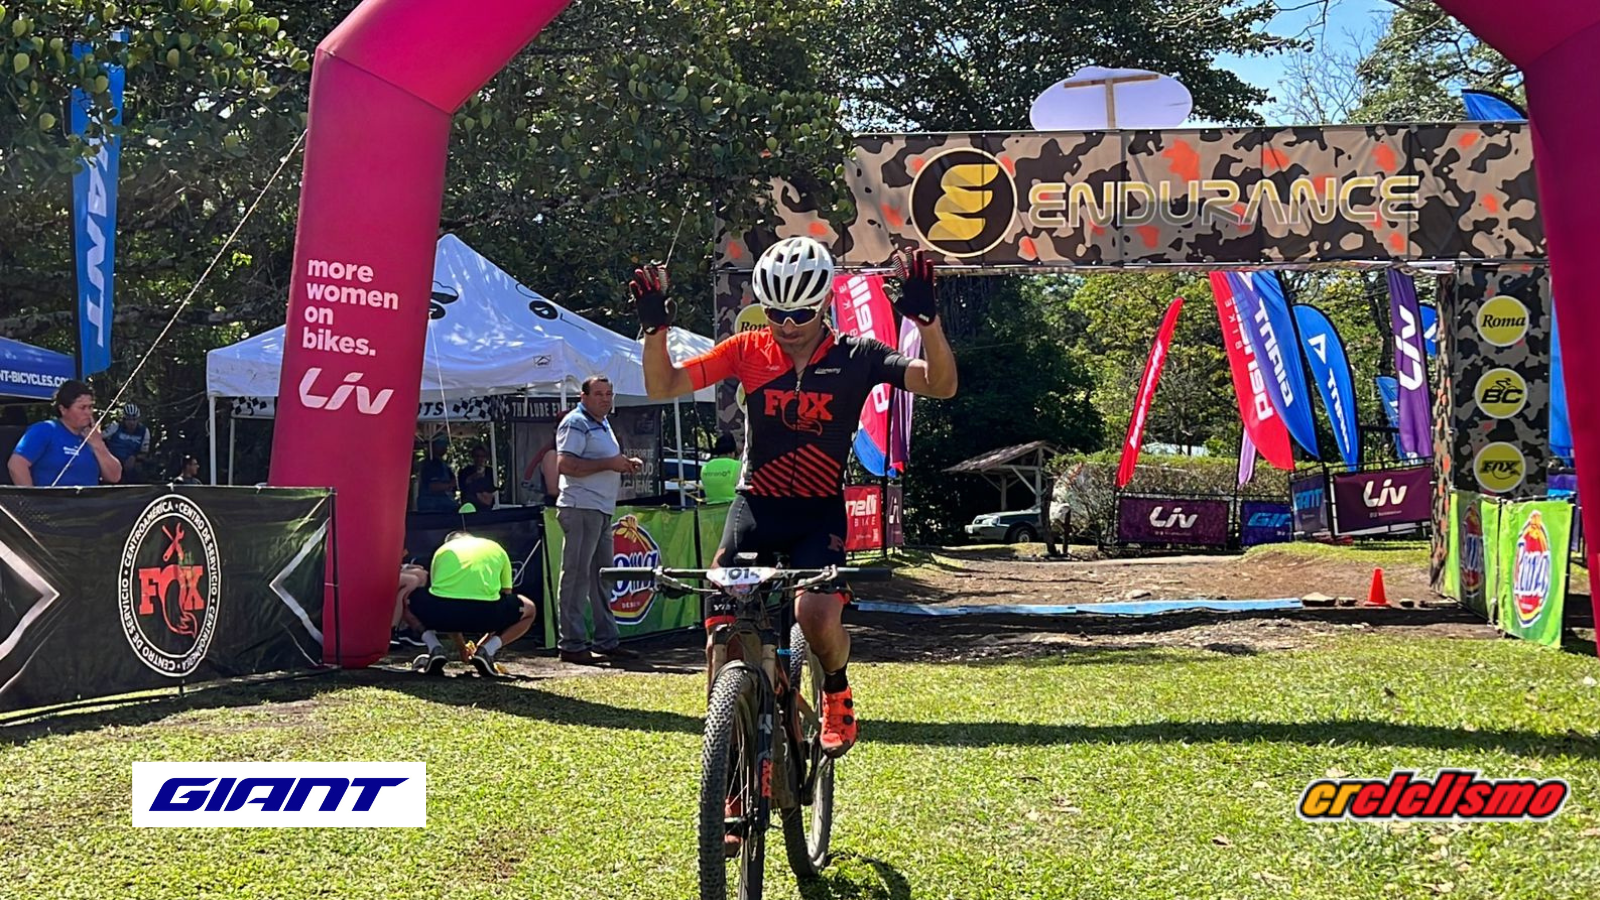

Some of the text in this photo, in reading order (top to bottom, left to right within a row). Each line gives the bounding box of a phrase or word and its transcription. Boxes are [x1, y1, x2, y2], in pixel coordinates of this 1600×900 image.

[1028, 175, 1420, 228] ENDURANCE
[308, 258, 374, 283] more
[306, 283, 399, 310] women
[304, 304, 334, 326] on
[1481, 314, 1526, 329] Roma
[302, 327, 377, 356] bikes.
[1395, 304, 1423, 391] Liv
[299, 367, 394, 415] Liv
[1481, 388, 1524, 404] BC
[529, 402, 550, 417] LUBE
[763, 388, 834, 428] FOX
[1363, 478, 1408, 509] Liv
[179, 502, 205, 530] CENTRO
[1149, 506, 1199, 529] Liv
[201, 527, 211, 543] DE
[206, 543, 218, 596] SERVICIO
[611, 549, 659, 600] oma
[121, 578, 137, 636] SERVICIO
[138, 564, 205, 628] FOX
[132, 634, 144, 651] DE
[142, 647, 176, 671] CENTRO
